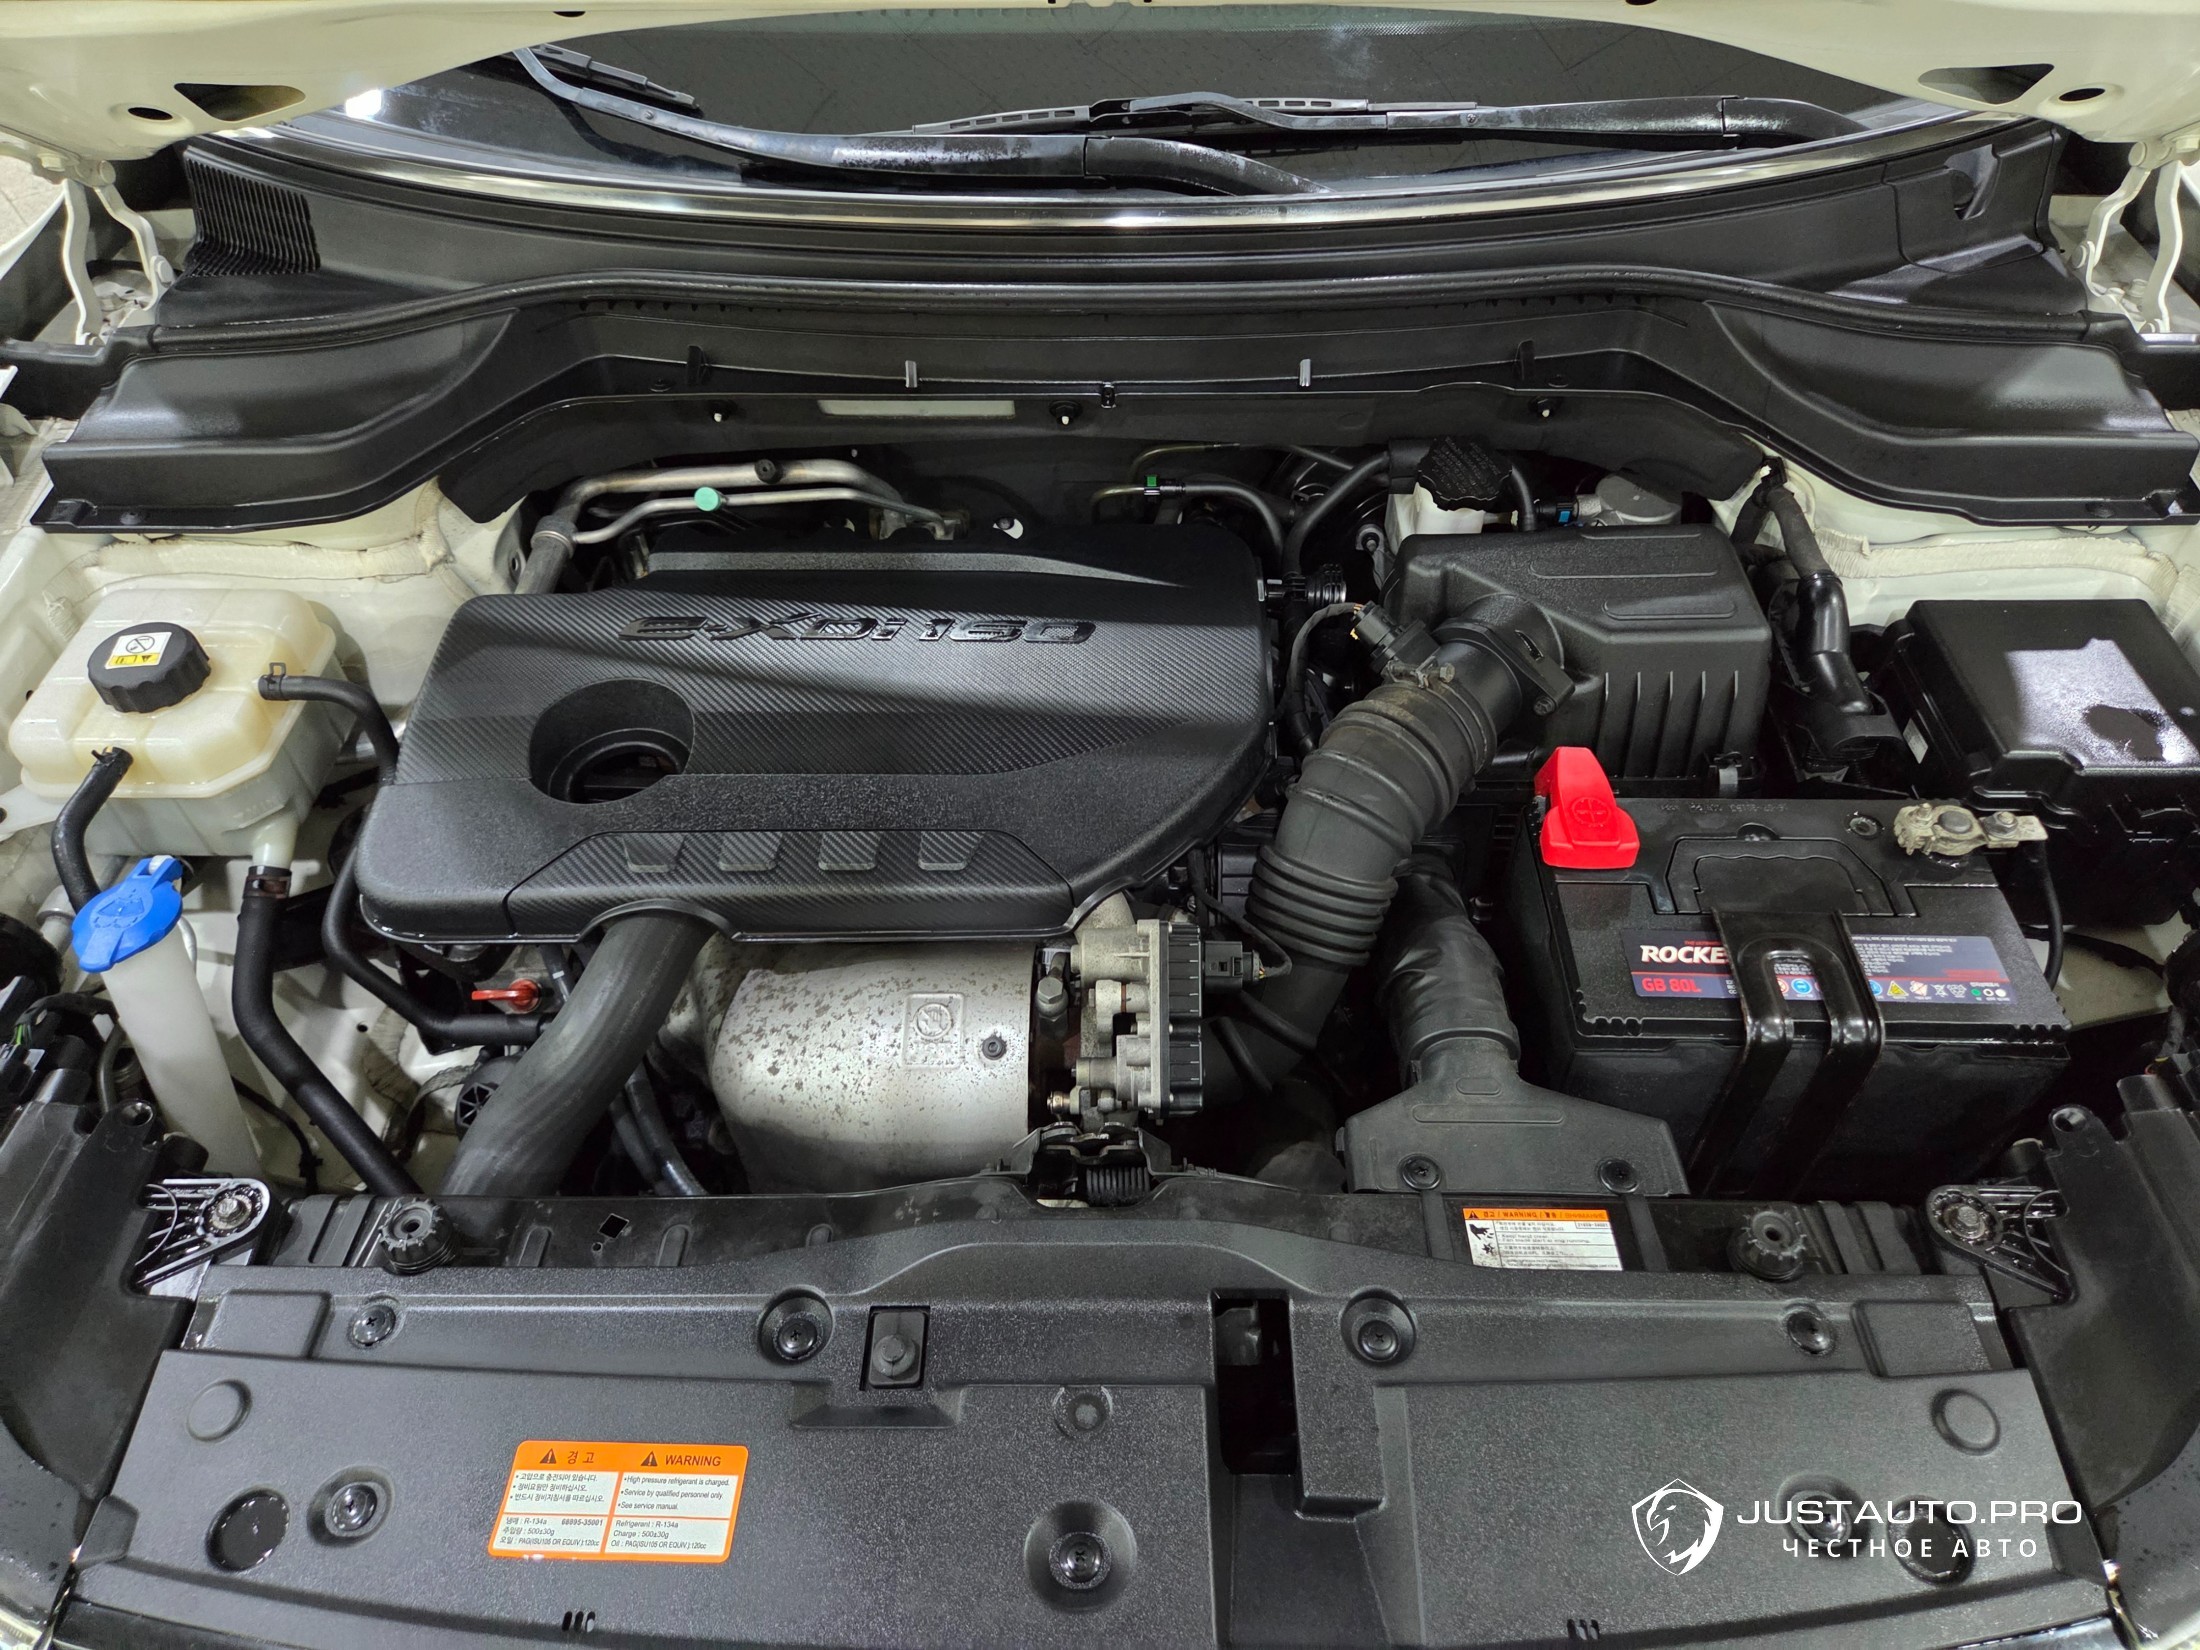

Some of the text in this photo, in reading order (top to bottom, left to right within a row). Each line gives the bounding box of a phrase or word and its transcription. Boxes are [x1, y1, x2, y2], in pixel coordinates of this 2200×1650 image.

[1640, 945, 1729, 964] ROCKE
[1641, 977, 1702, 993] GB 80L
[665, 1454, 721, 1467] WARNING
[626, 1475, 641, 1485] High
[668, 1477, 698, 1486] refrigerant
[704, 1479, 730, 1487] charged.
[623, 1488, 646, 1496] Service
[646, 1489, 655, 1497] by
[655, 1489, 680, 1498] qualified
[680, 1491, 709, 1499] personnel
[620, 1501, 633, 1509] See
[615, 1519, 651, 1529] Refrigerant
[656, 1520, 679, 1528] R-134a
[527, 1528, 555, 1537] 500±30g
[613, 1530, 637, 1539] Charge
[641, 1531, 670, 1540] 500±30g
